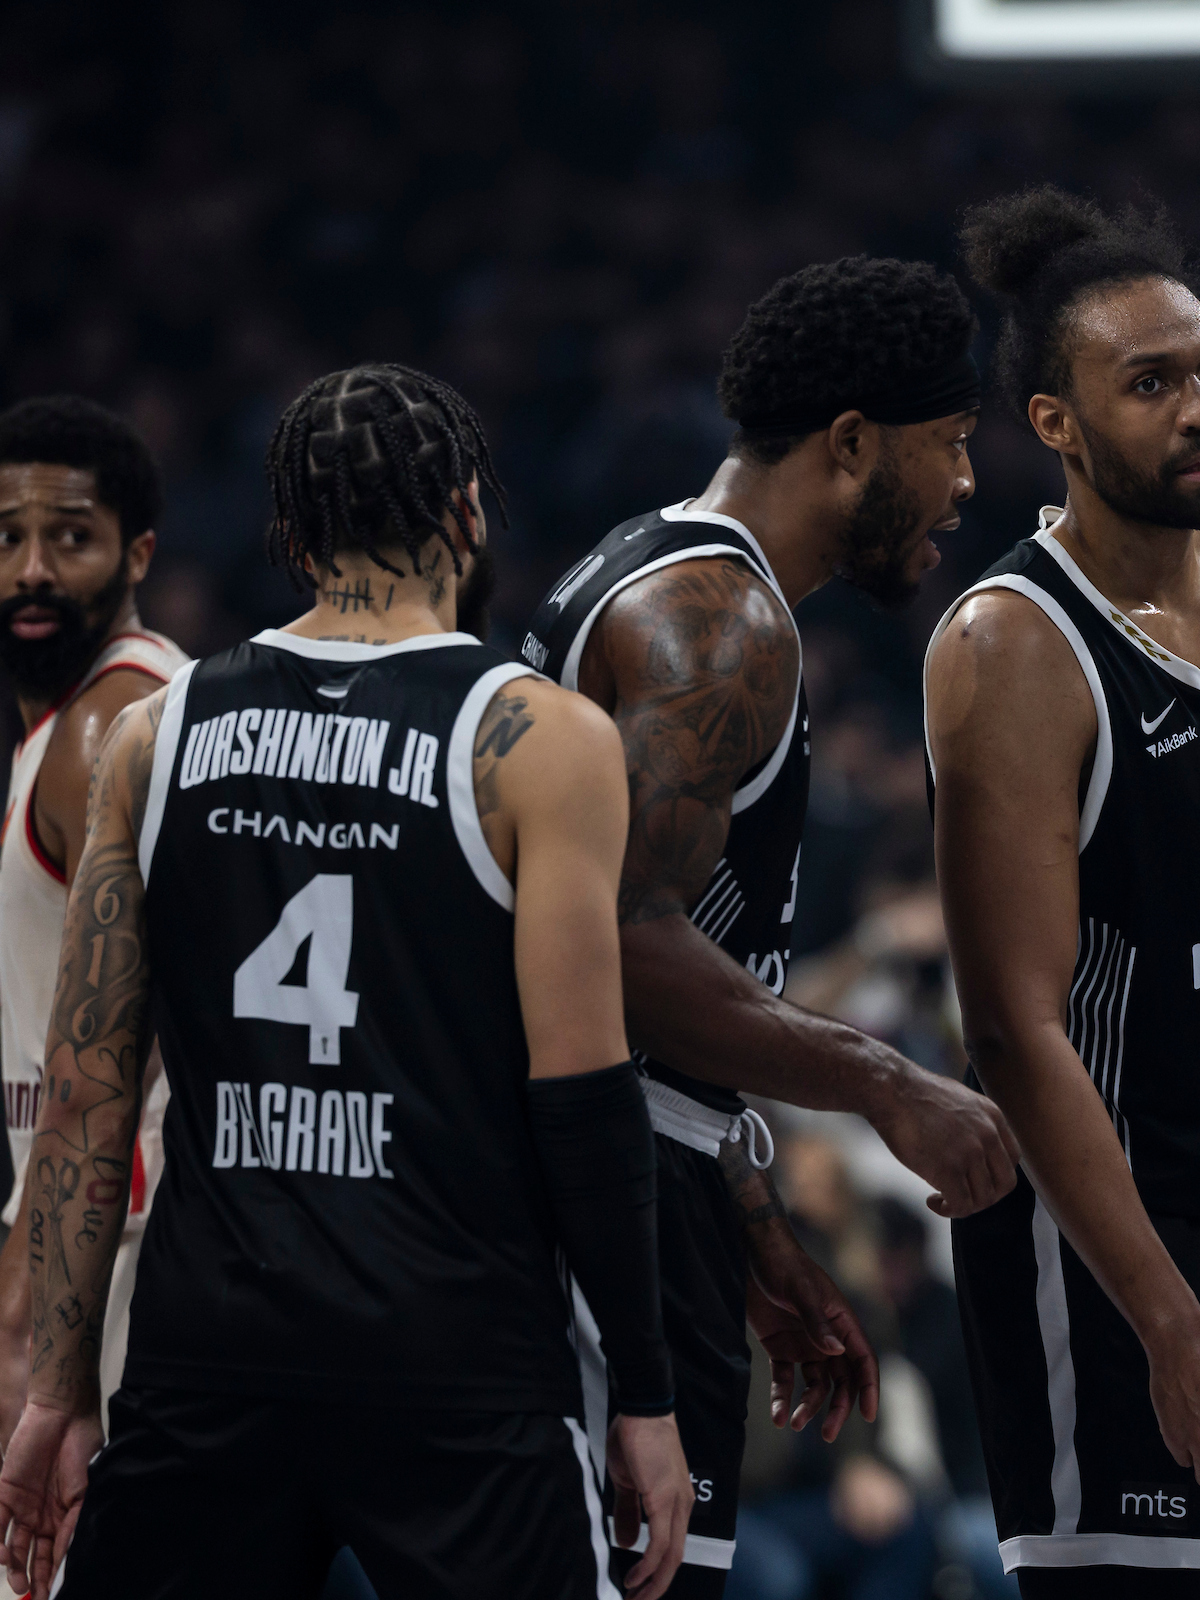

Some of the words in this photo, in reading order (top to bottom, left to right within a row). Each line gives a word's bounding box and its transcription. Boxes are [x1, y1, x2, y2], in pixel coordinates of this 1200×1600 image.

[1156, 725, 1199, 758] AikBank
[388, 727, 440, 808] JR
[207, 807, 400, 850] CHANGAN
[233, 873, 360, 1066] 4
[1121, 1489, 1187, 1518] mts
